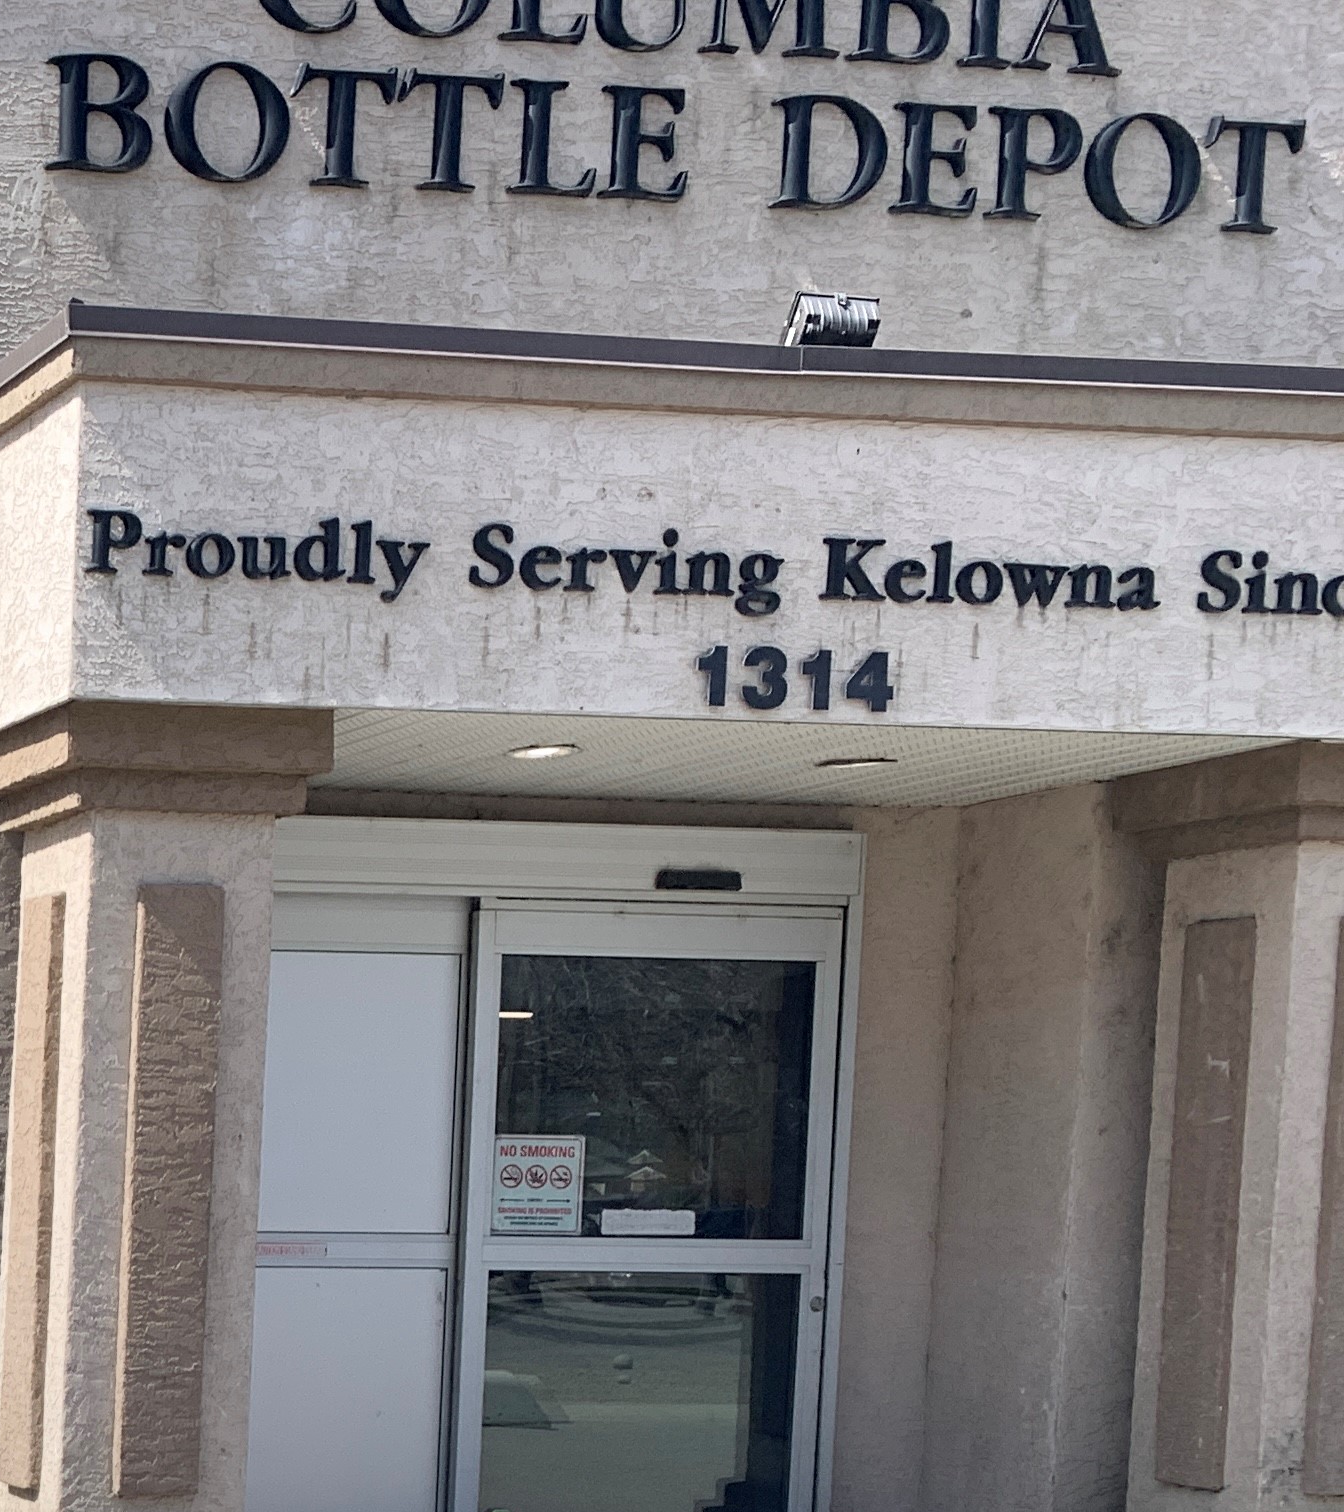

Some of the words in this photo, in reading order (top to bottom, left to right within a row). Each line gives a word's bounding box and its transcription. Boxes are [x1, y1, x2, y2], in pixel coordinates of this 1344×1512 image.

[44, 53, 689, 202] BOTTLE
[768, 93, 1307, 235] DEPOT
[84, 509, 430, 602] Proudly
[469, 524, 785, 618] Serving
[819, 537, 1160, 613] Kelowna
[697, 645, 895, 714] 1314
[500, 1145, 517, 1156] NO
[520, 1145, 575, 1158] SMOKING
